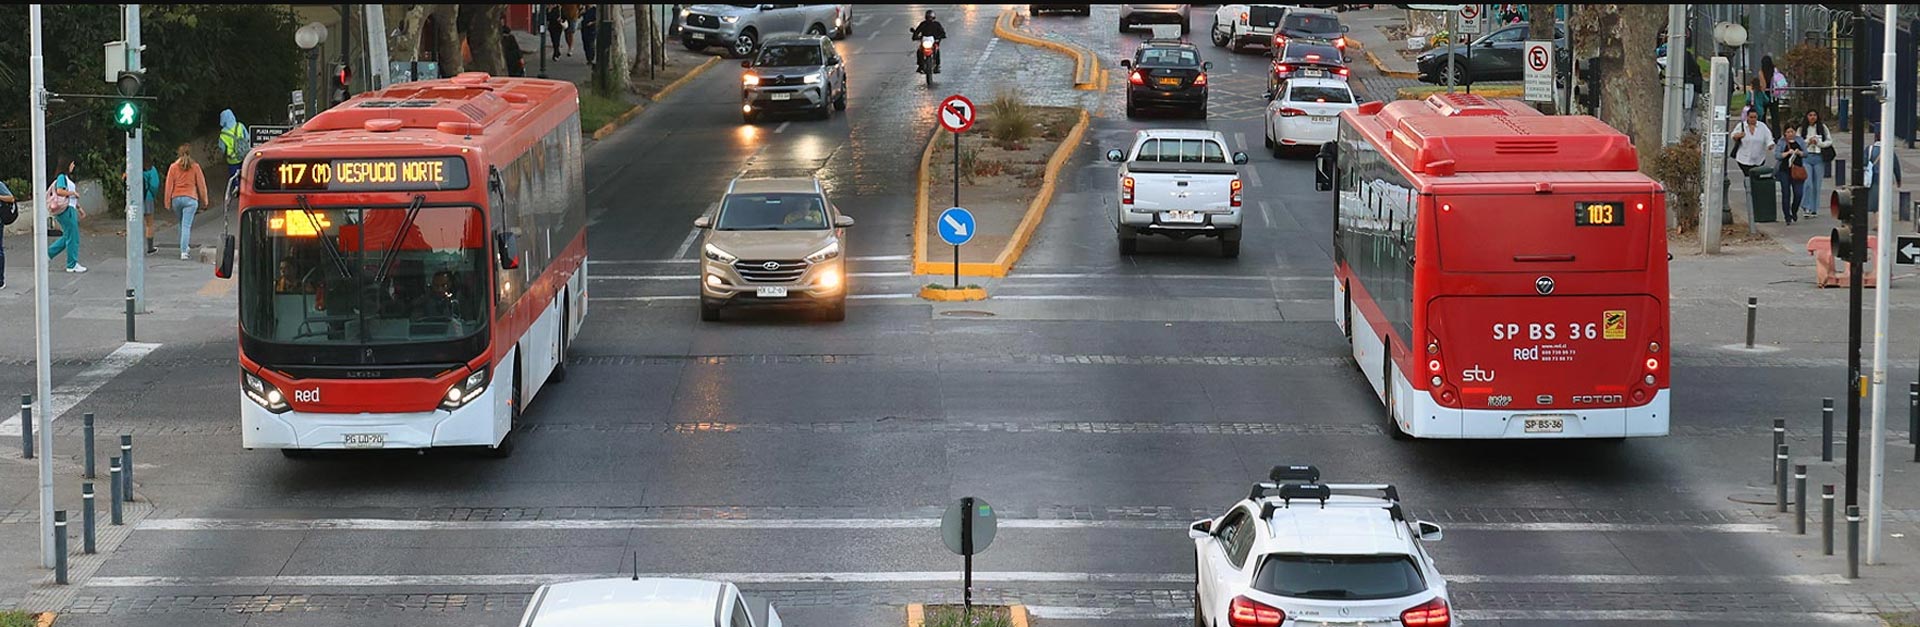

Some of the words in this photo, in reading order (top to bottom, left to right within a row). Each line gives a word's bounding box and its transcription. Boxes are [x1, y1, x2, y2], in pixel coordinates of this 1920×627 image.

[279, 163, 307, 184] 117
[312, 163, 332, 184] (M)
[337, 162, 396, 184] VESPUCIO
[402, 161, 444, 182] NORTE
[1587, 204, 1612, 224] 103
[1493, 323, 1520, 340] SP
[1529, 323, 1556, 340] BS
[1569, 323, 1597, 340] 36
[1513, 344, 1538, 360] Red
[1462, 364, 1494, 382] stu
[294, 387, 320, 402] Red
[1573, 395, 1622, 404] FOTON
[1526, 420, 1537, 429] SP
[346, 434, 356, 443] PG
